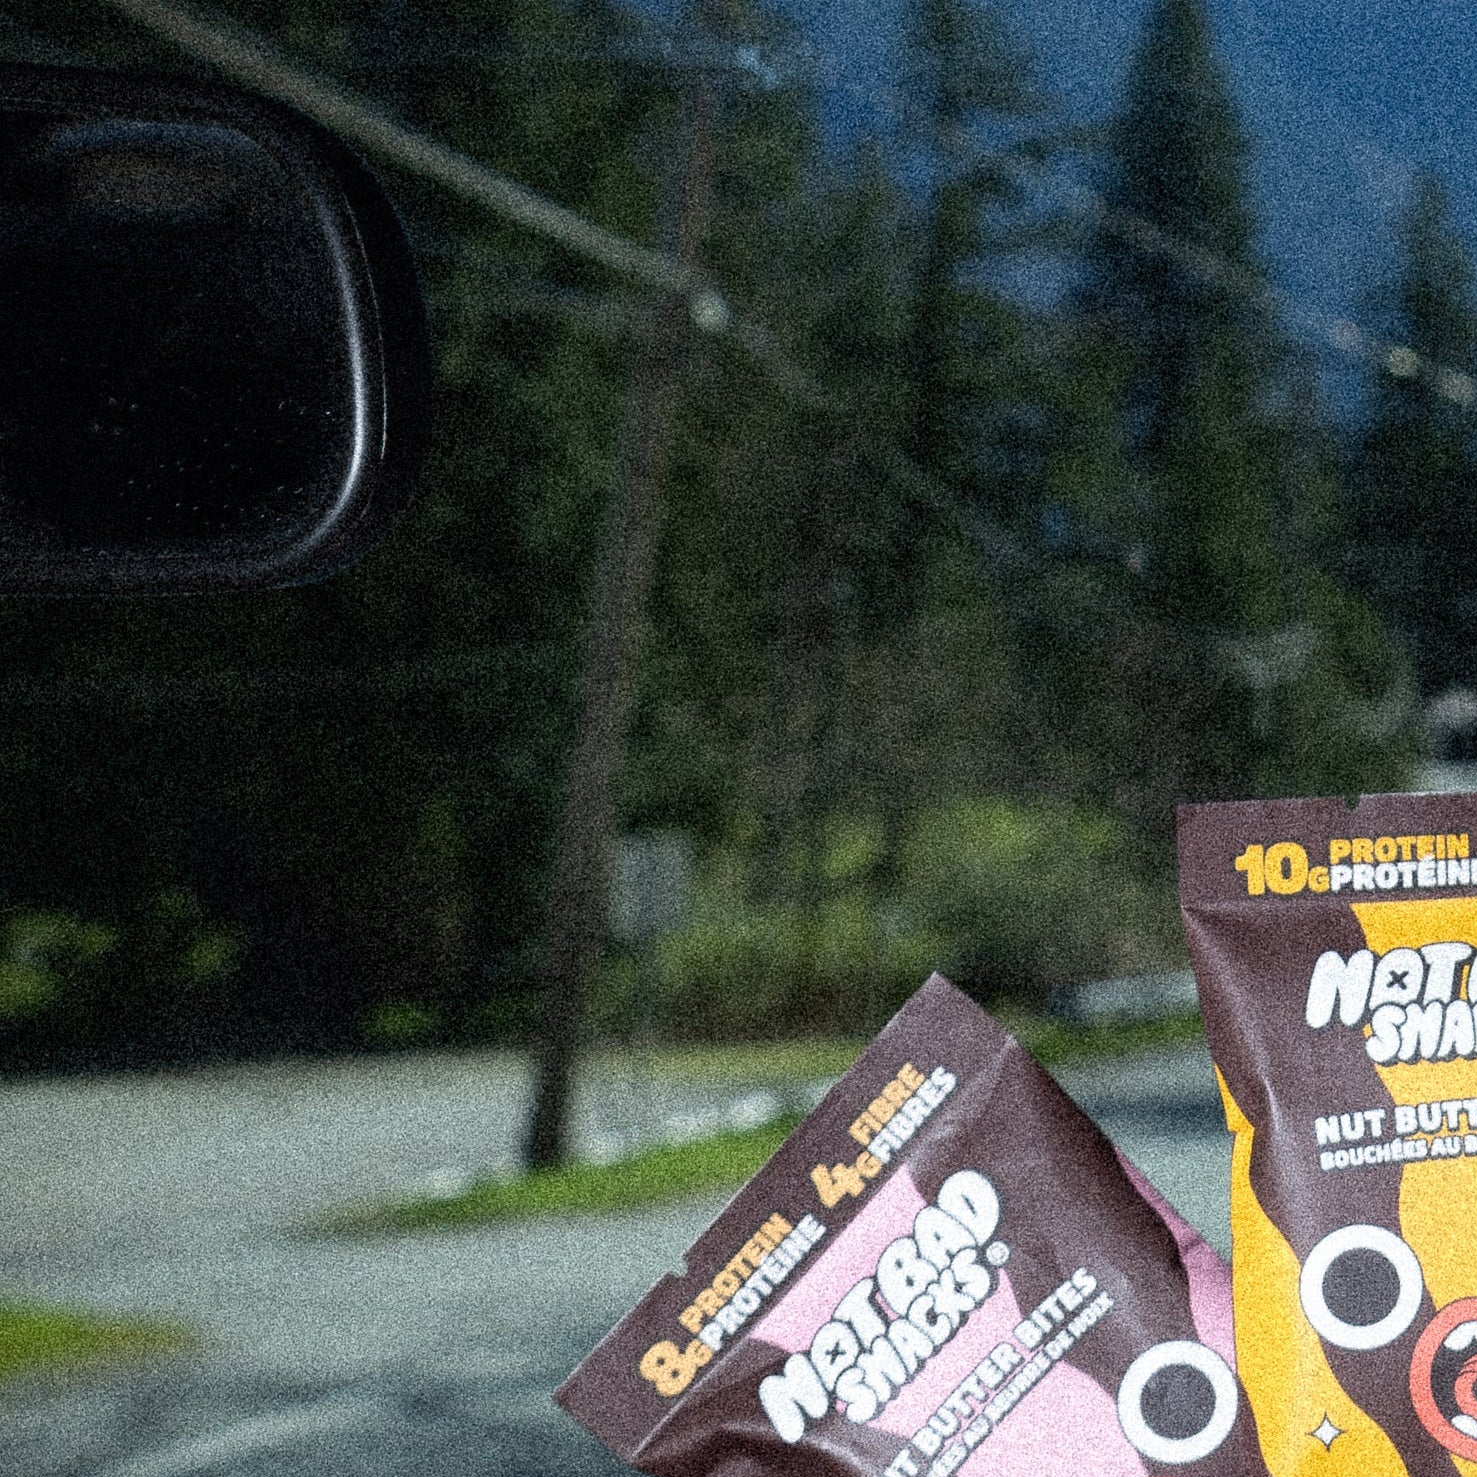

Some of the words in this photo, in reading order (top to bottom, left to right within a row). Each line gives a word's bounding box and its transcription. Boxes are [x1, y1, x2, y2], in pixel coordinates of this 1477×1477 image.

[1329, 833, 1470, 865] PROTEIN
[1306, 941, 1474, 1029] NOT
[867, 1066, 957, 1163] FIBRES
[1314, 1109, 1386, 1145] NUT
[1432, 1137, 1461, 1158] AU
[679, 1212, 792, 1333] PROTEIN
[848, 1062, 927, 1146] FIBRE
[759, 1277, 881, 1444] NOT
[875, 1169, 1000, 1316] BAD
[833, 1248, 993, 1424] SNACKS
[911, 1343, 1023, 1456] BUTTER
[1013, 1267, 1097, 1350] BITES
